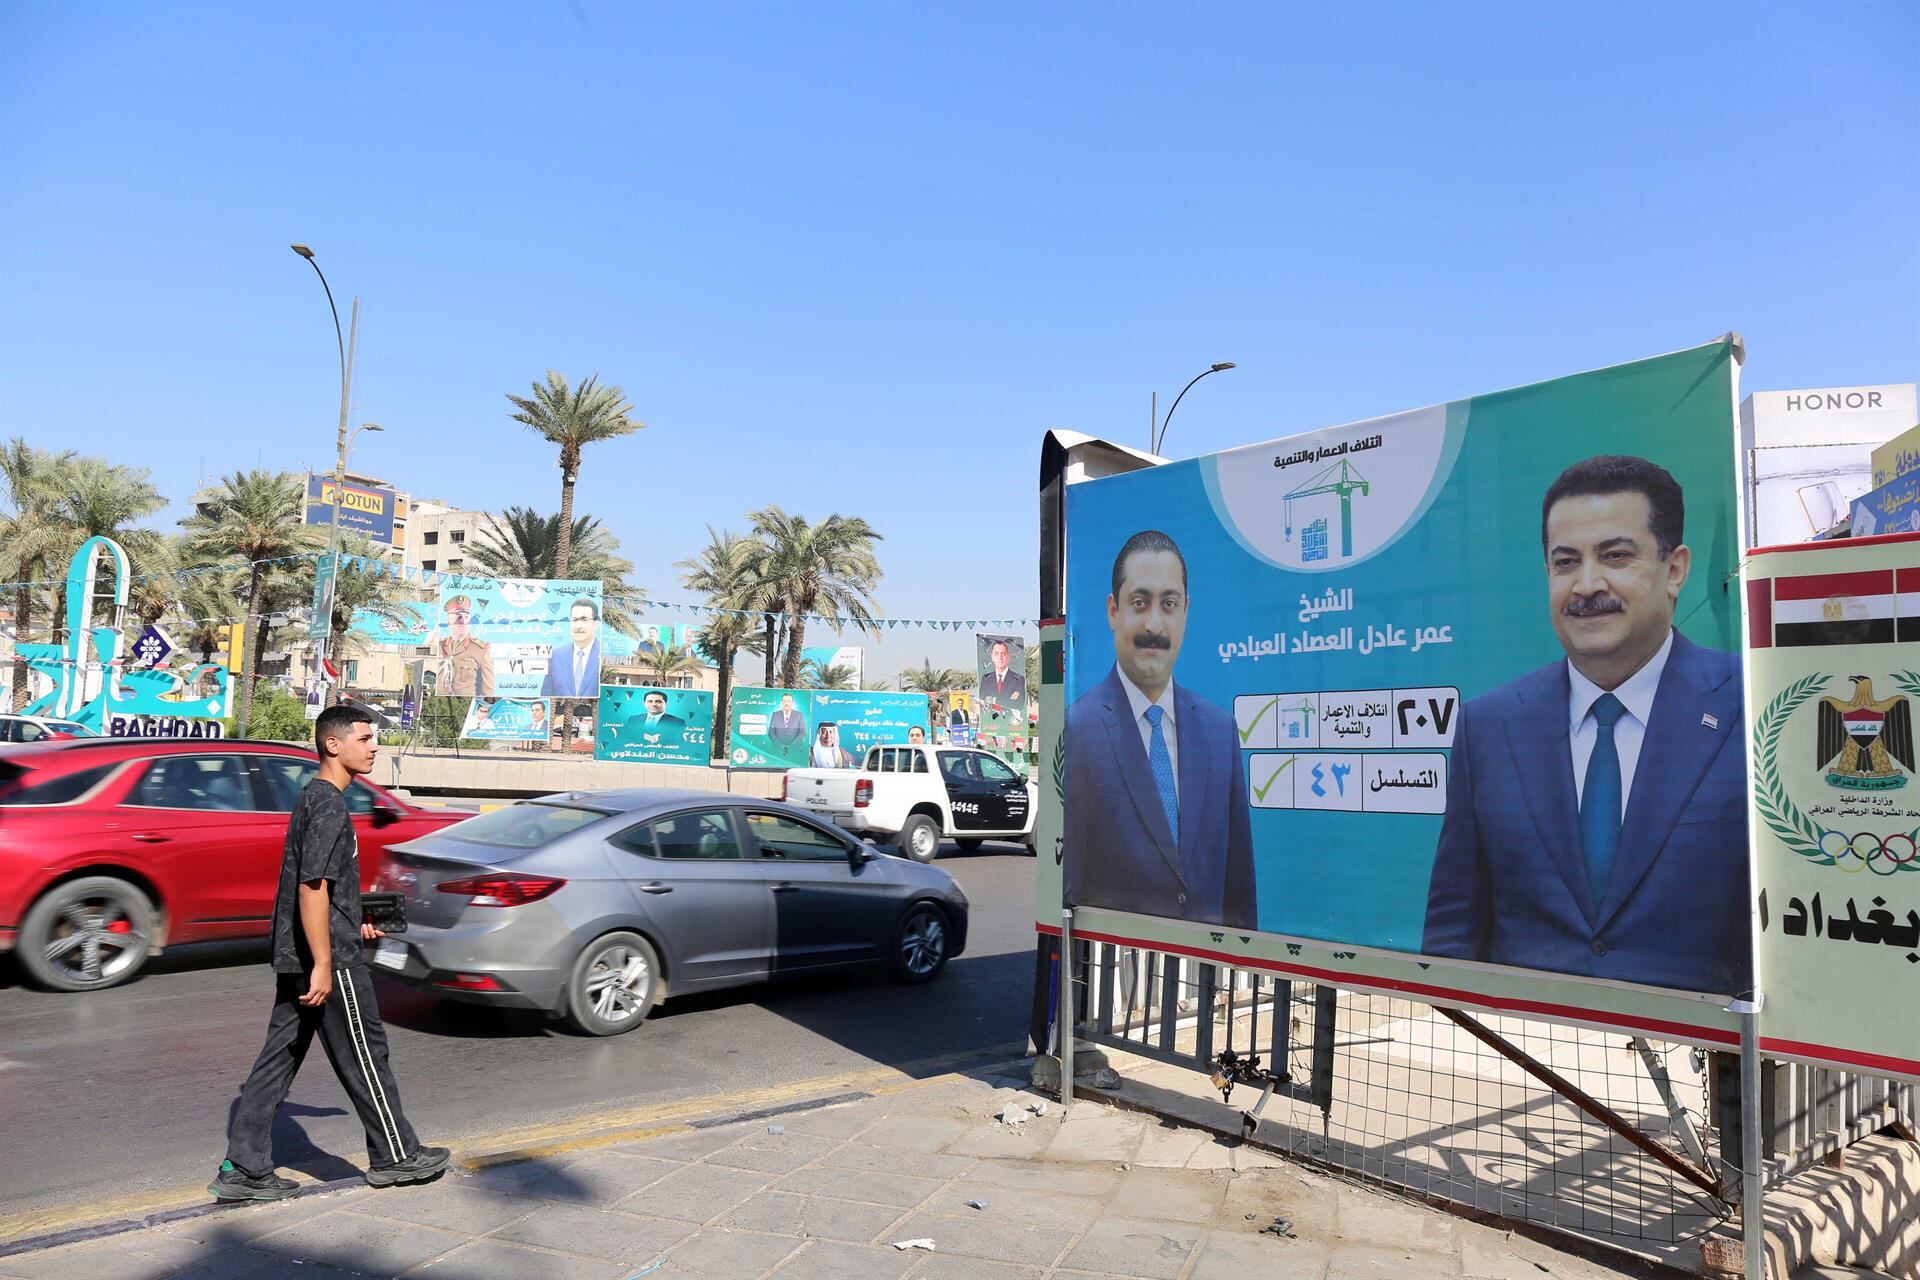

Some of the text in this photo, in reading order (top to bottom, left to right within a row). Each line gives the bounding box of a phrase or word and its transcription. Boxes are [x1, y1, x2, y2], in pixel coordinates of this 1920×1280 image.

[1786, 391, 1883, 411] HONOR
[1273, 434, 1383, 469] ائتلاف الاعمار والتنمية
[1298, 587, 1353, 623] الشيخ
[1218, 623, 1453, 663] عمر عادل العصاد العبادي
[1321, 703, 1388, 722] ائتلاف الاعمار
[1396, 697, 1455, 736] ٢٠٧
[110, 717, 221, 739] BAGHDAD
[1333, 720, 1371, 739] والتنمية
[610, 750, 690, 760] محسن المندلاوي
[1310, 761, 1438, 798] التسلسل ٤٣
[1840, 795, 1894, 806] وزارة الداخلية
[1808, 805, 1920, 818] حاد الشرطة الرياضي العراقي
